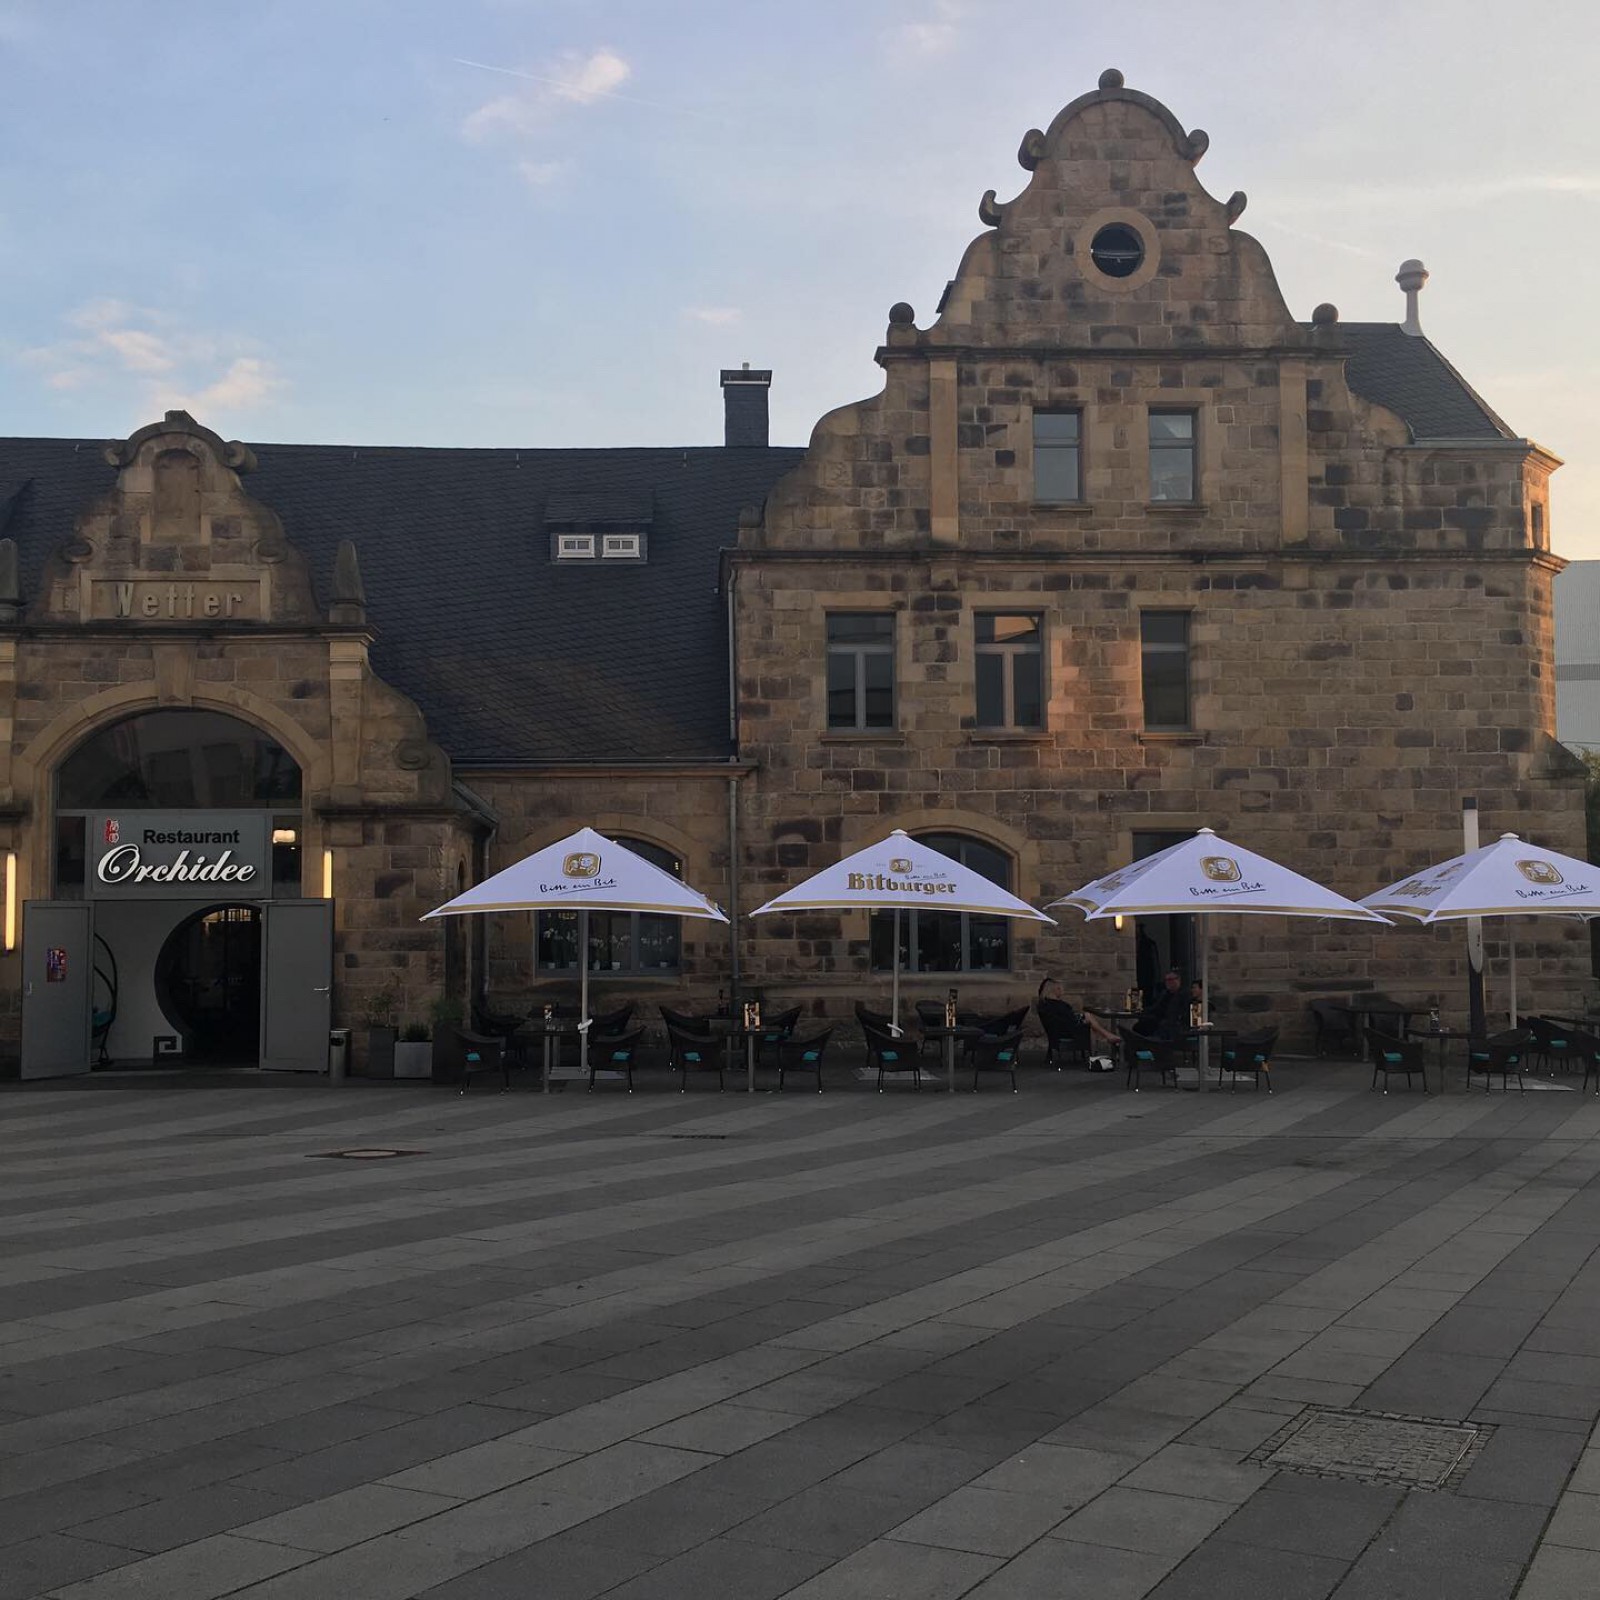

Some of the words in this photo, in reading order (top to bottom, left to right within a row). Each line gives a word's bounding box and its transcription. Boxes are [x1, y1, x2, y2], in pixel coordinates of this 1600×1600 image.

[115, 582, 242, 618] Wetter
[143, 829, 240, 844] Restaurant
[97, 843, 256, 883] Orchidee
[540, 884, 569, 893] Bitte
[846, 872, 957, 895] Bitburger
